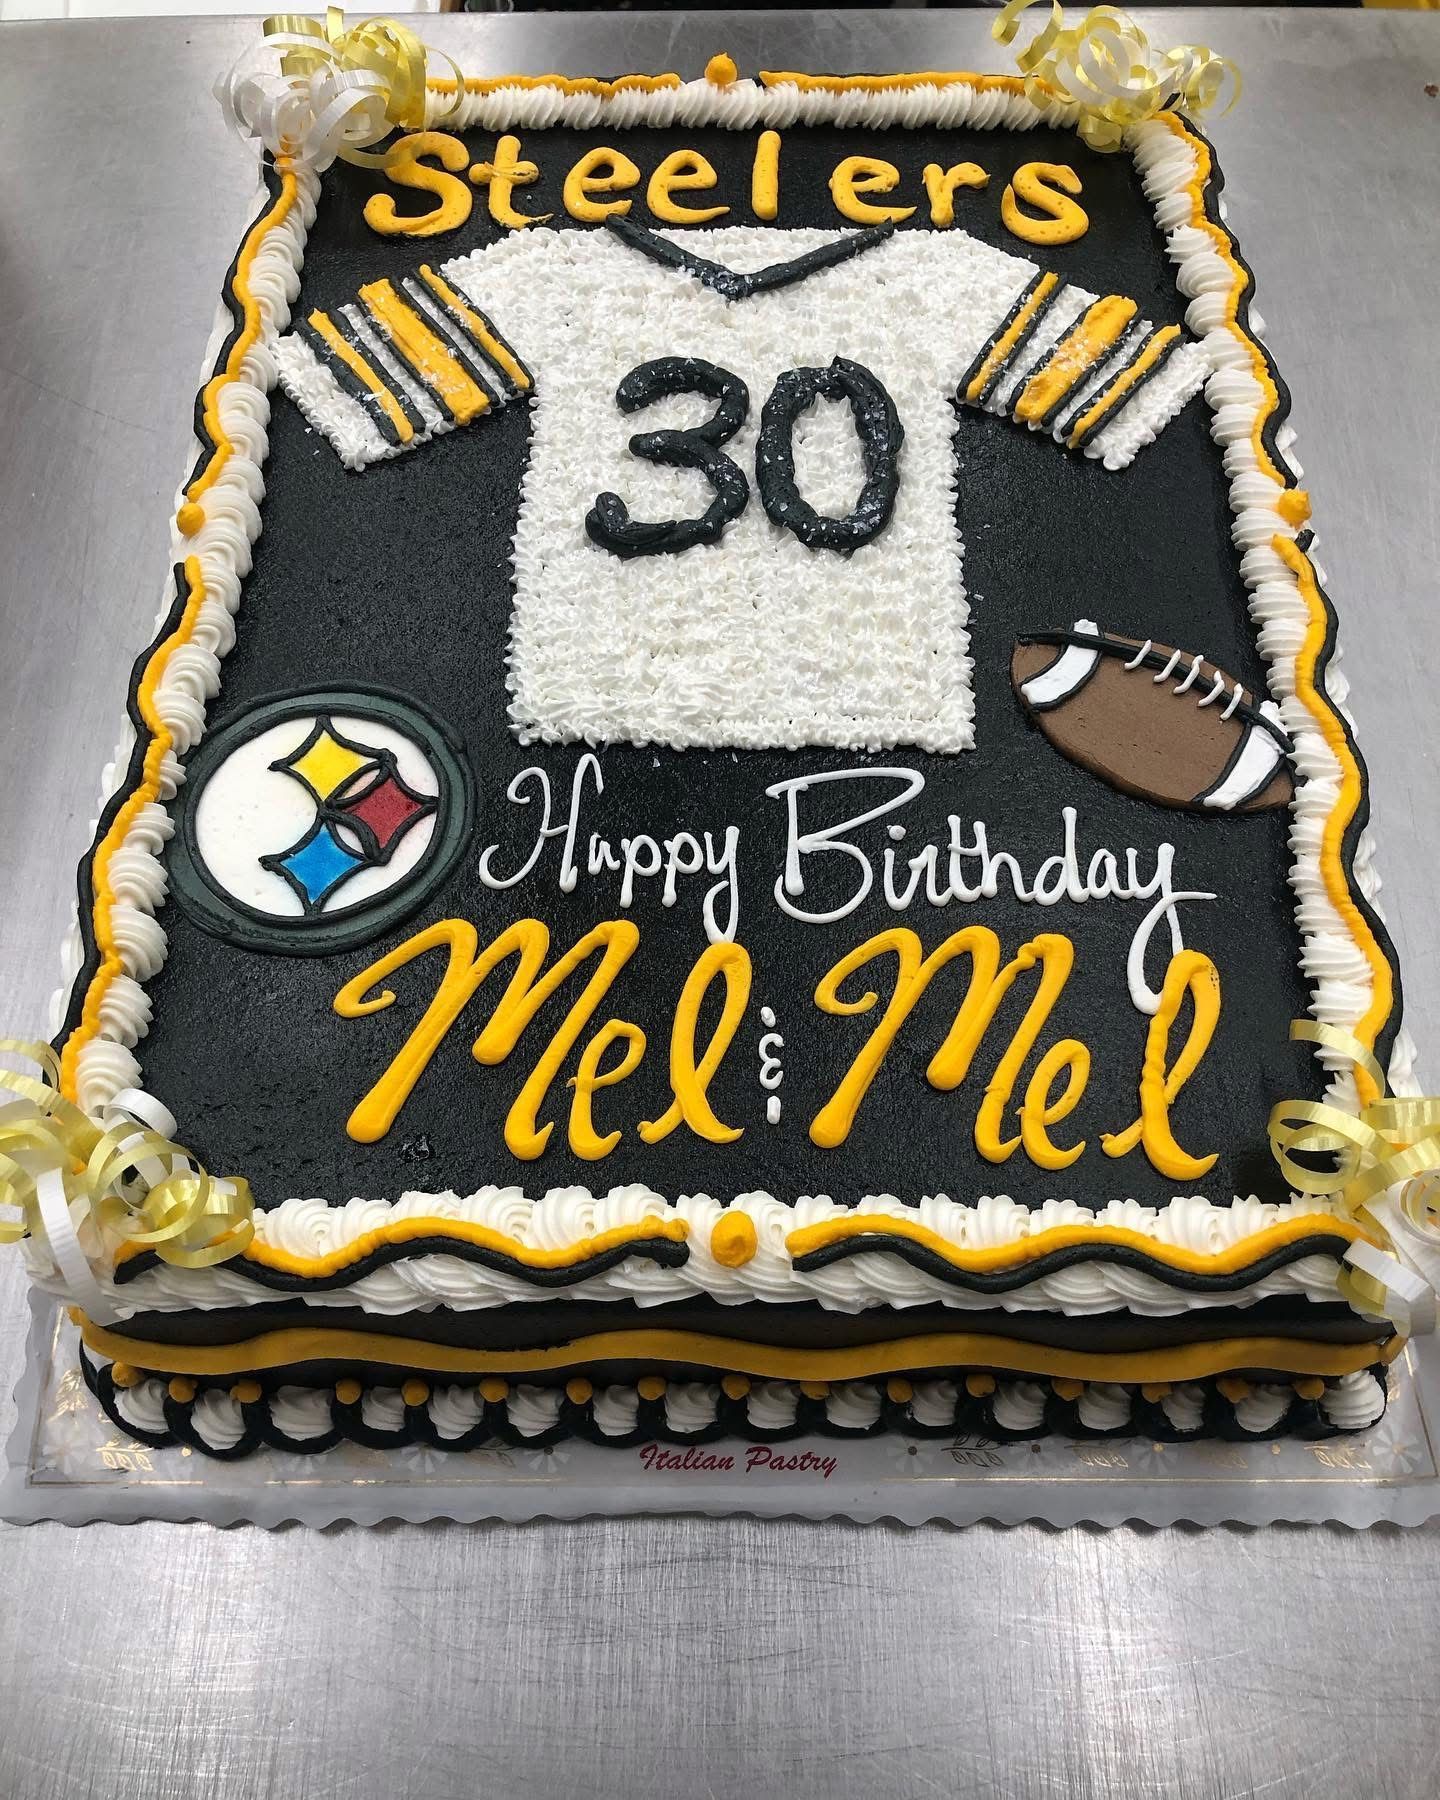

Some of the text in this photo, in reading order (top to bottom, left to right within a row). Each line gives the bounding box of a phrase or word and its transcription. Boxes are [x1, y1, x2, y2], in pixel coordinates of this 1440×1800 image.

[363, 130, 1090, 245] Steelers
[585, 356, 905, 559] 30
[478, 752, 1217, 1015] Happy Birthday
[333, 918, 753, 1161] Mel
[808, 925, 1222, 1180] Mel
[640, 1444, 837, 1478] Italian Pastry
